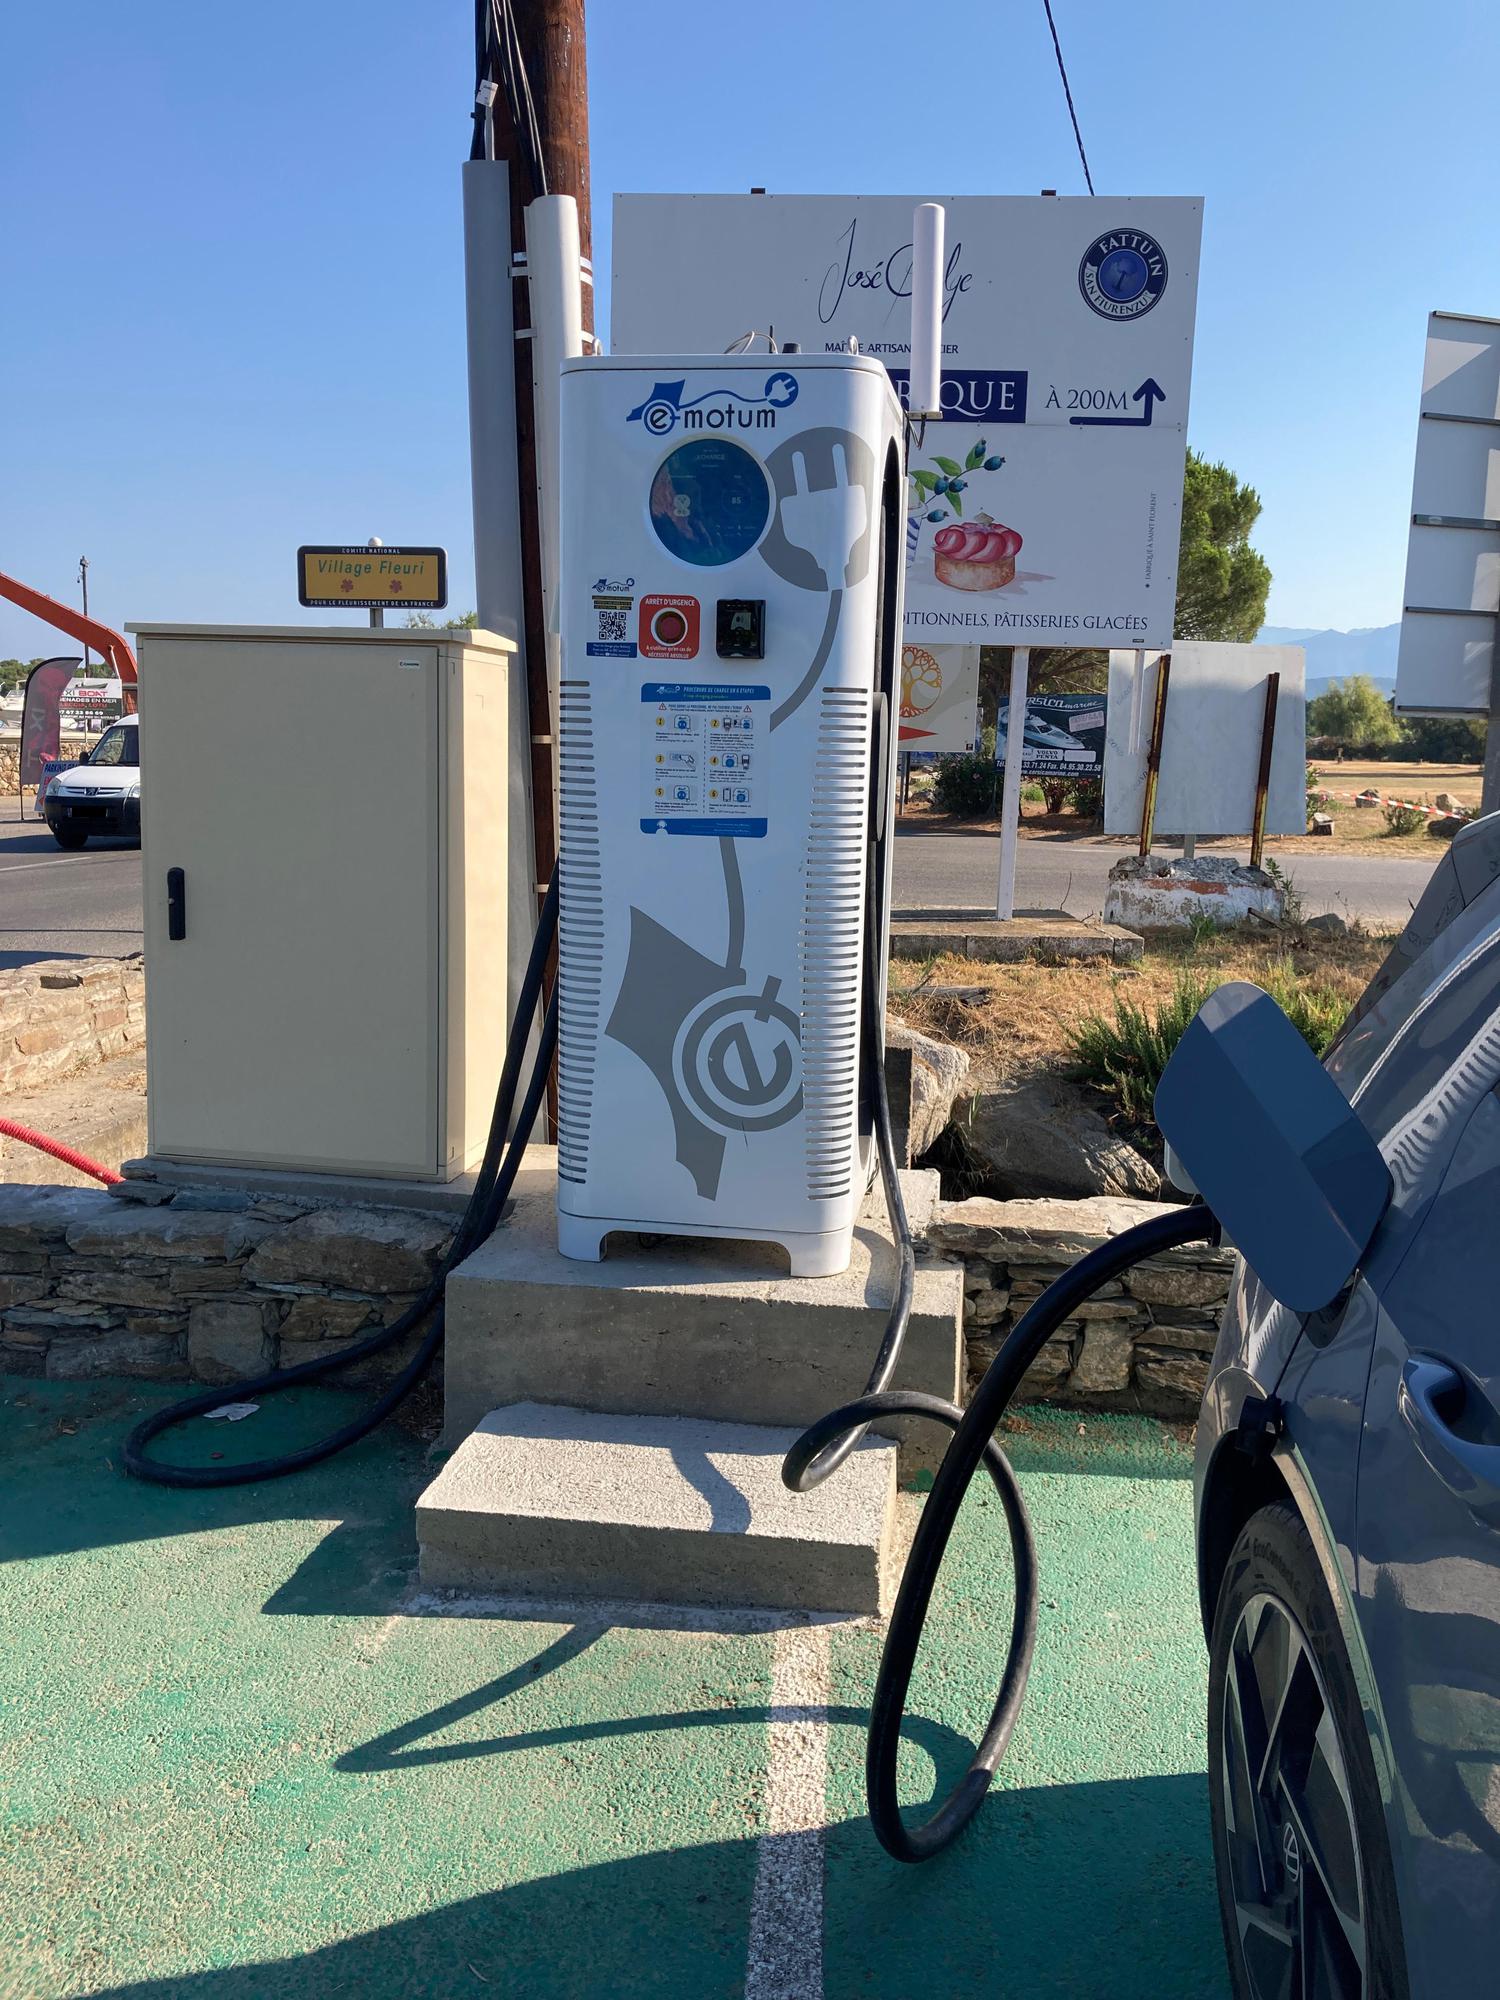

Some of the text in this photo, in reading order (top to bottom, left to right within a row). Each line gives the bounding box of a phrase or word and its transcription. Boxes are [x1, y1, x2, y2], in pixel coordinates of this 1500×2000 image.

[1099, 234, 1162, 276] FATTU IN
[1085, 272, 1149, 314] SAN FIURENZU
[825, 340, 864, 353] MAÎE
[868, 343, 911, 353] ARTISAN
[896, 379, 1016, 417] RQUE
[1045, 385, 1129, 410] À 200M
[318, 560, 425, 577] Village Fleuri
[664, 598, 695, 606] D'URGENCE
[903, 611, 1148, 630] ITIONNELS, PÂTISSERIES GLACÉES
[1023, 761, 1047, 769] 33.71.24
